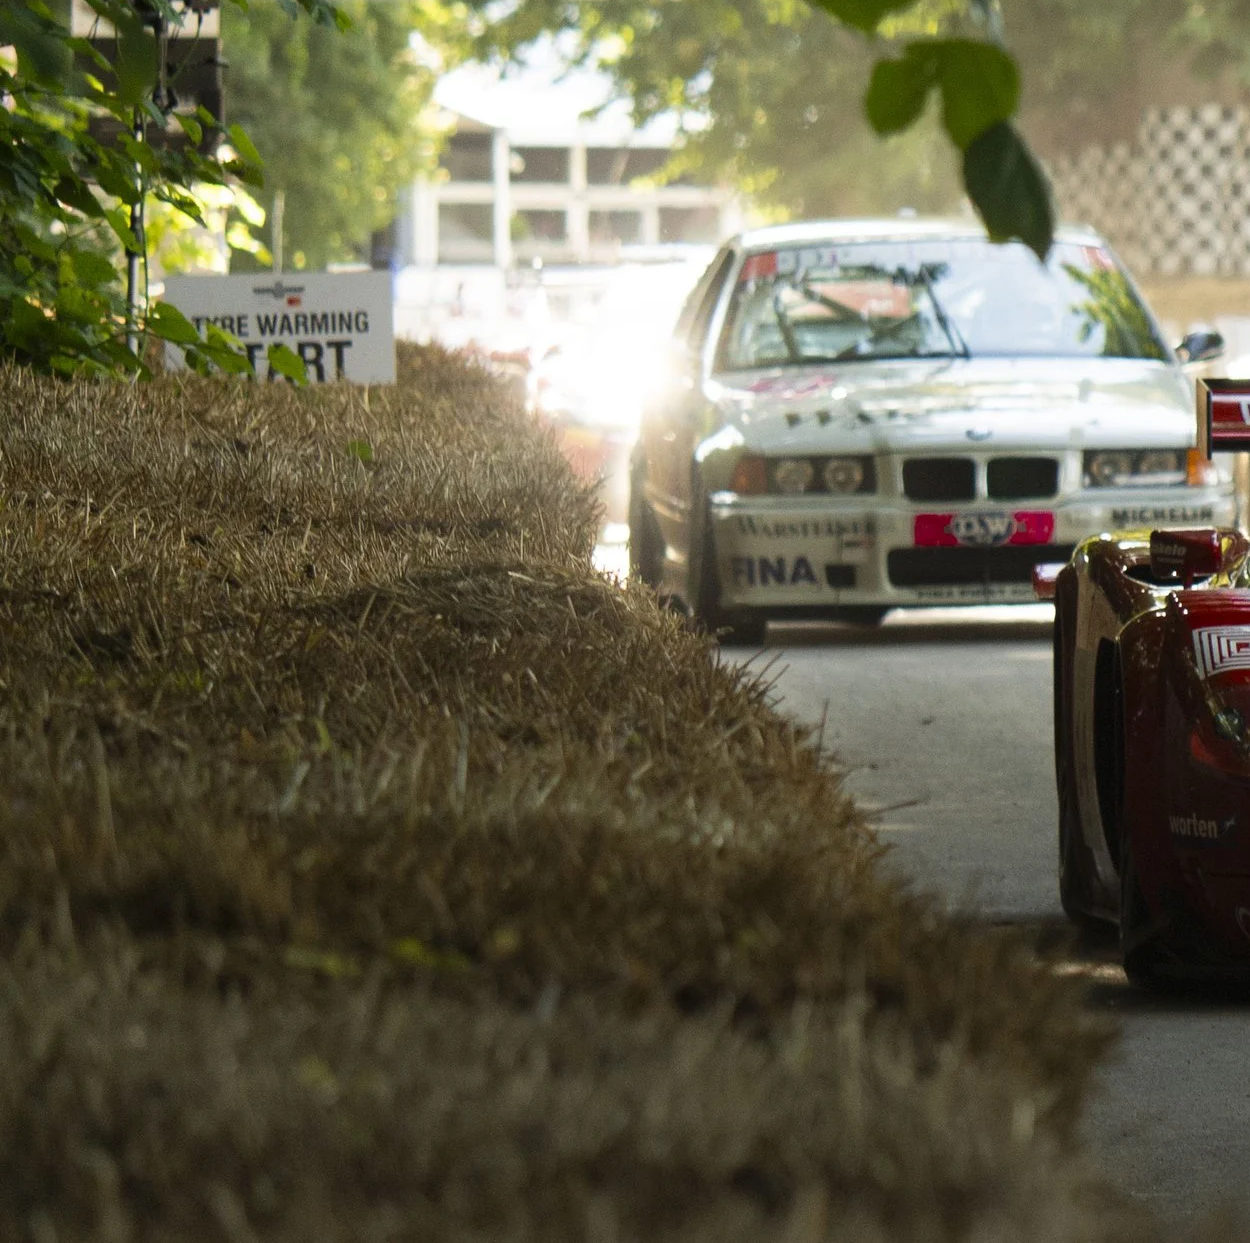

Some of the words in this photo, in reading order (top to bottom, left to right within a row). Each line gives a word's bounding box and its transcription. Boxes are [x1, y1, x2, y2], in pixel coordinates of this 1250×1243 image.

[256, 311, 369, 336] WARMING
[1112, 507, 1213, 525] MICHELIN
[732, 556, 818, 586] FINA
[1169, 812, 1218, 839] worten
